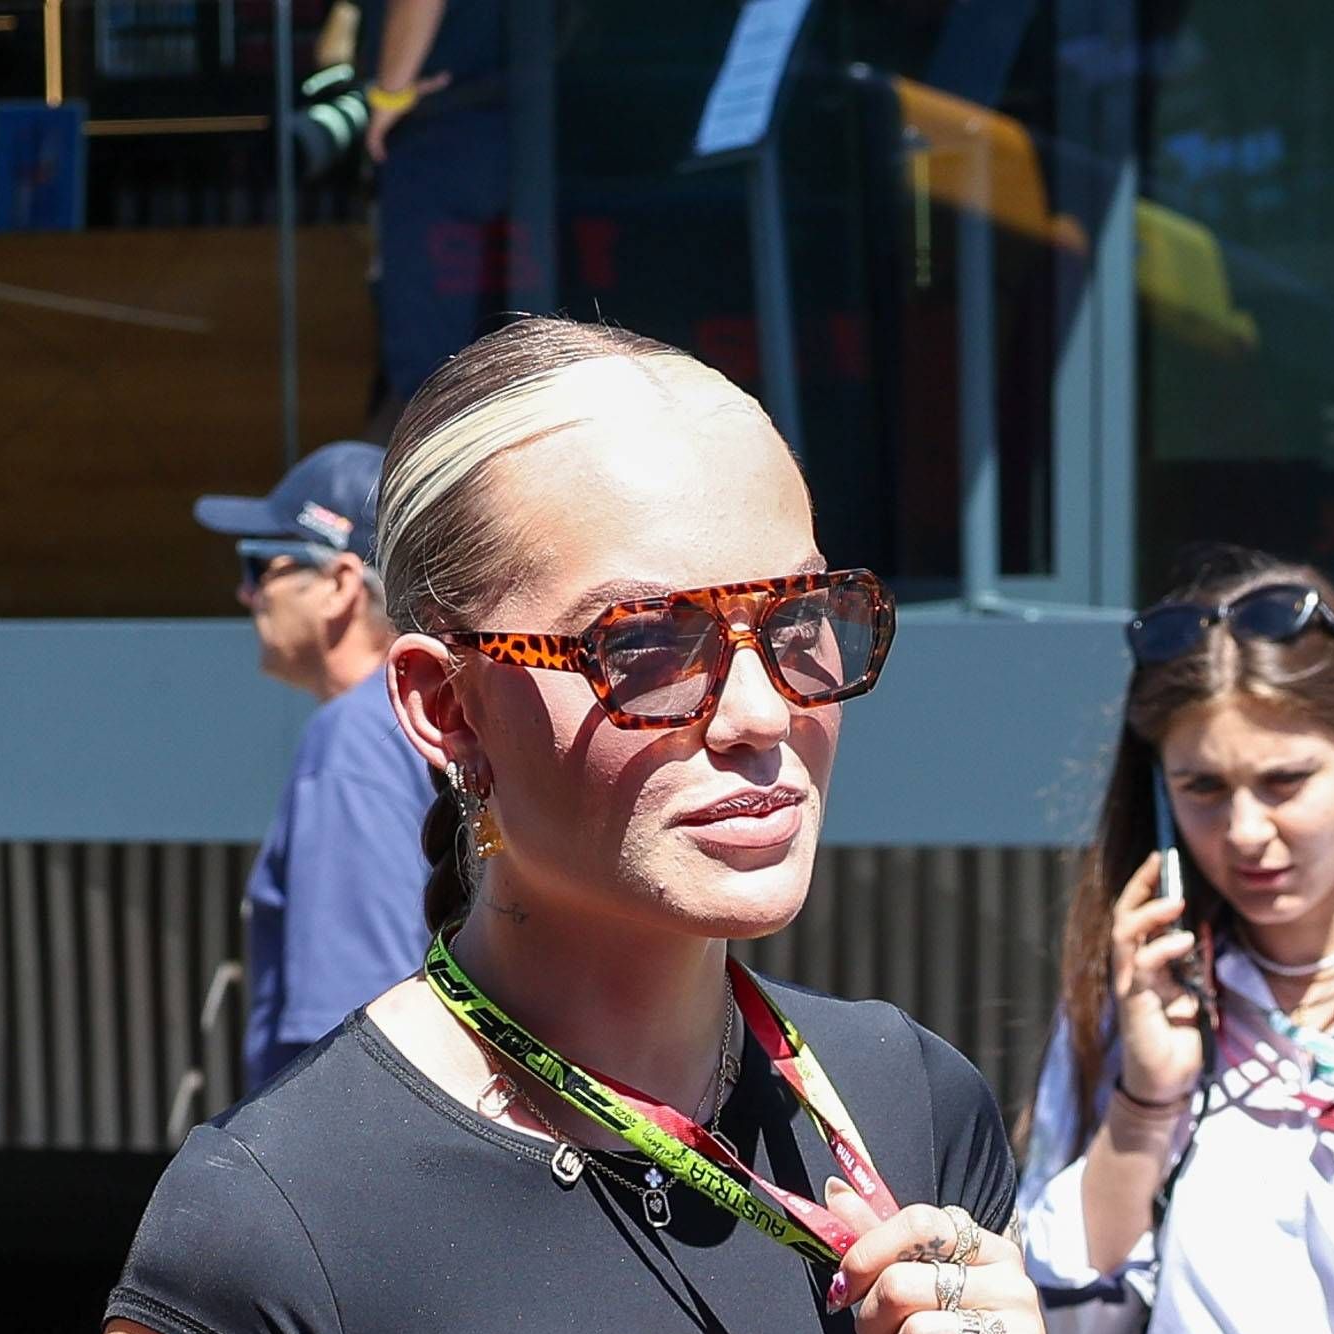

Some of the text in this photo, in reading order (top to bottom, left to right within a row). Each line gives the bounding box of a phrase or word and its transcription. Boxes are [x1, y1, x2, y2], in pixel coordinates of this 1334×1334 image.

[525, 1052, 565, 1090] VIP
[612, 1107, 638, 1128] 2025
[689, 1162, 786, 1237] AUSTRIA
